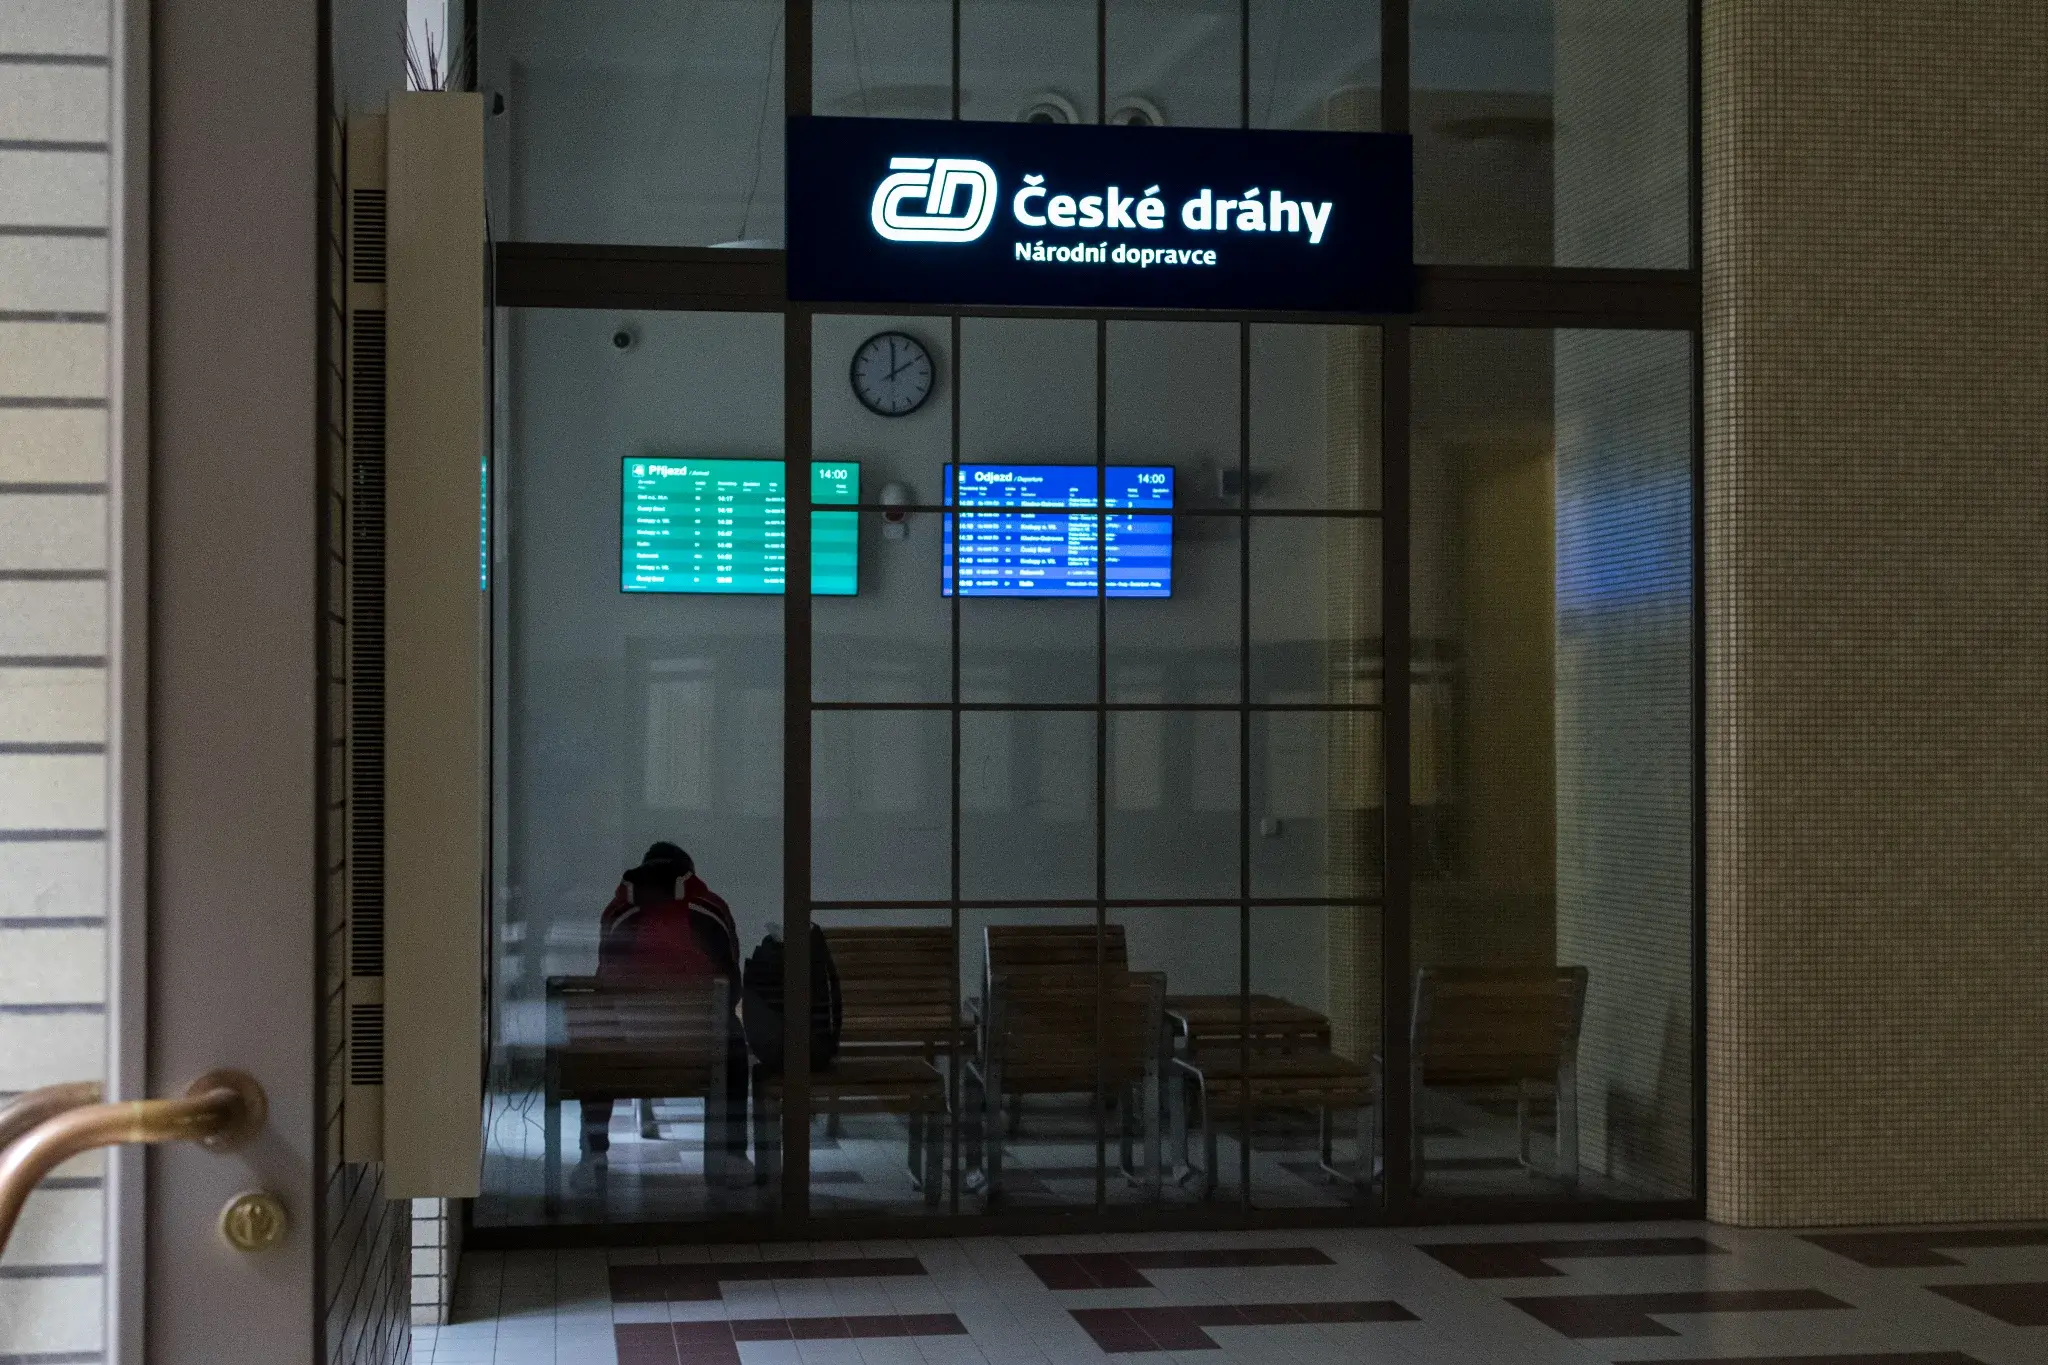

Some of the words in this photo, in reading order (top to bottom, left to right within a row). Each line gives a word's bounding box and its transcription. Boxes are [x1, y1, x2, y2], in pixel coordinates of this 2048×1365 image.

[871, 158, 997, 242] ČD
[1014, 174, 1164, 229] České
[1182, 188, 1332, 243] dráhy
[1016, 241, 1107, 262] Národní
[1112, 244, 1216, 268] dopravce
[649, 465, 687, 477] Příjezd
[820, 470, 847, 479] 14:00
[975, 472, 1012, 484] Odjezd
[1139, 474, 1165, 483] 14:00
